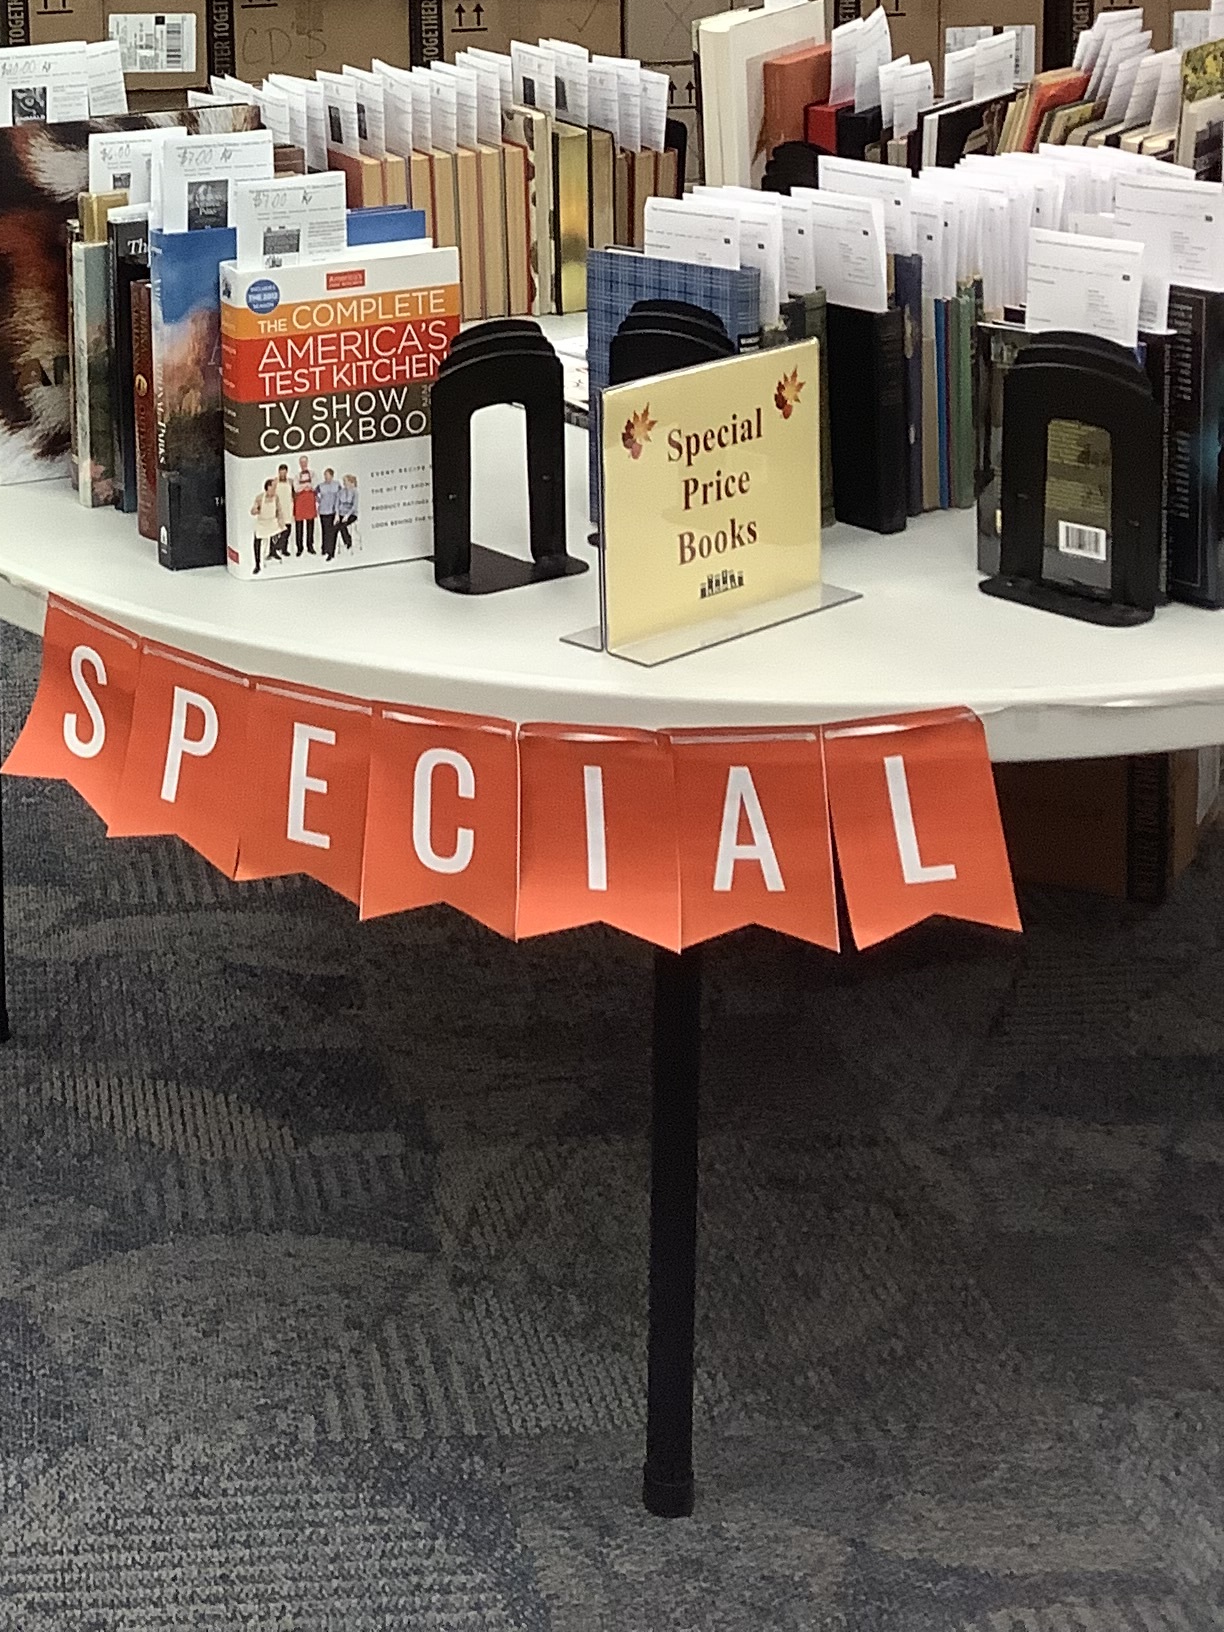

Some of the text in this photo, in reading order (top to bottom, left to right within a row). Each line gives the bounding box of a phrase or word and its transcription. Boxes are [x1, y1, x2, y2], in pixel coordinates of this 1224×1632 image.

[423, 0, 438, 62] TOGETHER
[216, 39, 231, 76] ETTER
[257, 290, 445, 334] THE COMPLETE
[259, 320, 447, 371] AMERICA'S
[258, 352, 447, 397] TEST KITCHEN
[259, 386, 408, 427] TV SHOW
[259, 411, 426, 454] COOKBOO
[667, 407, 764, 463] Special
[683, 469, 751, 511] Price
[678, 519, 758, 565] Books
[64, 645, 956, 892] SPECIAL
